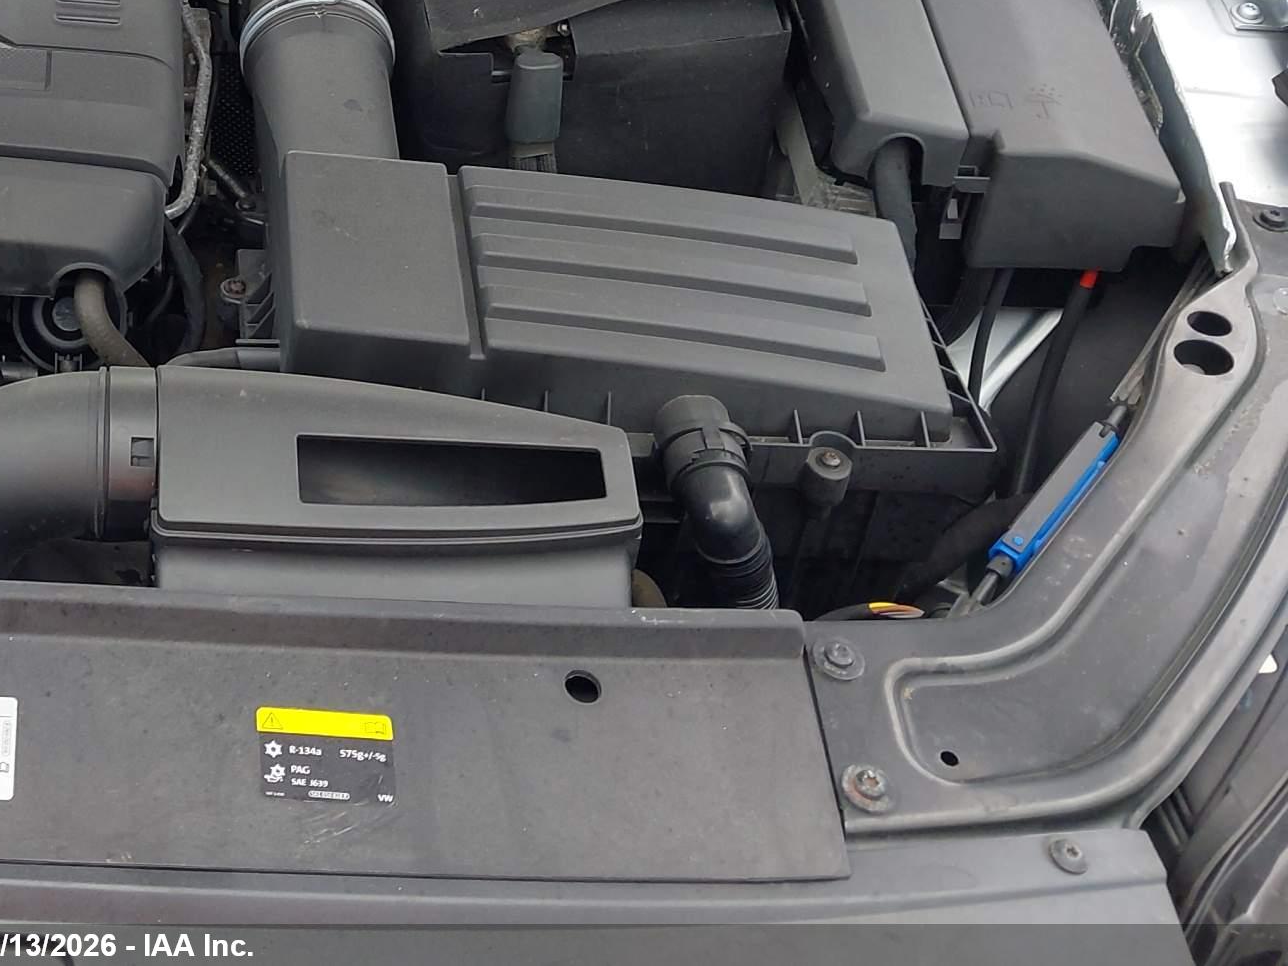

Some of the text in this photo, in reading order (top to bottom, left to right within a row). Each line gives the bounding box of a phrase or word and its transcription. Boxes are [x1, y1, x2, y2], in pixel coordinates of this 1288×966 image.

[289, 745, 322, 756] R-134a
[291, 765, 311, 774] PAG
[291, 778, 329, 788] SAE J639
[378, 794, 393, 802] VW
